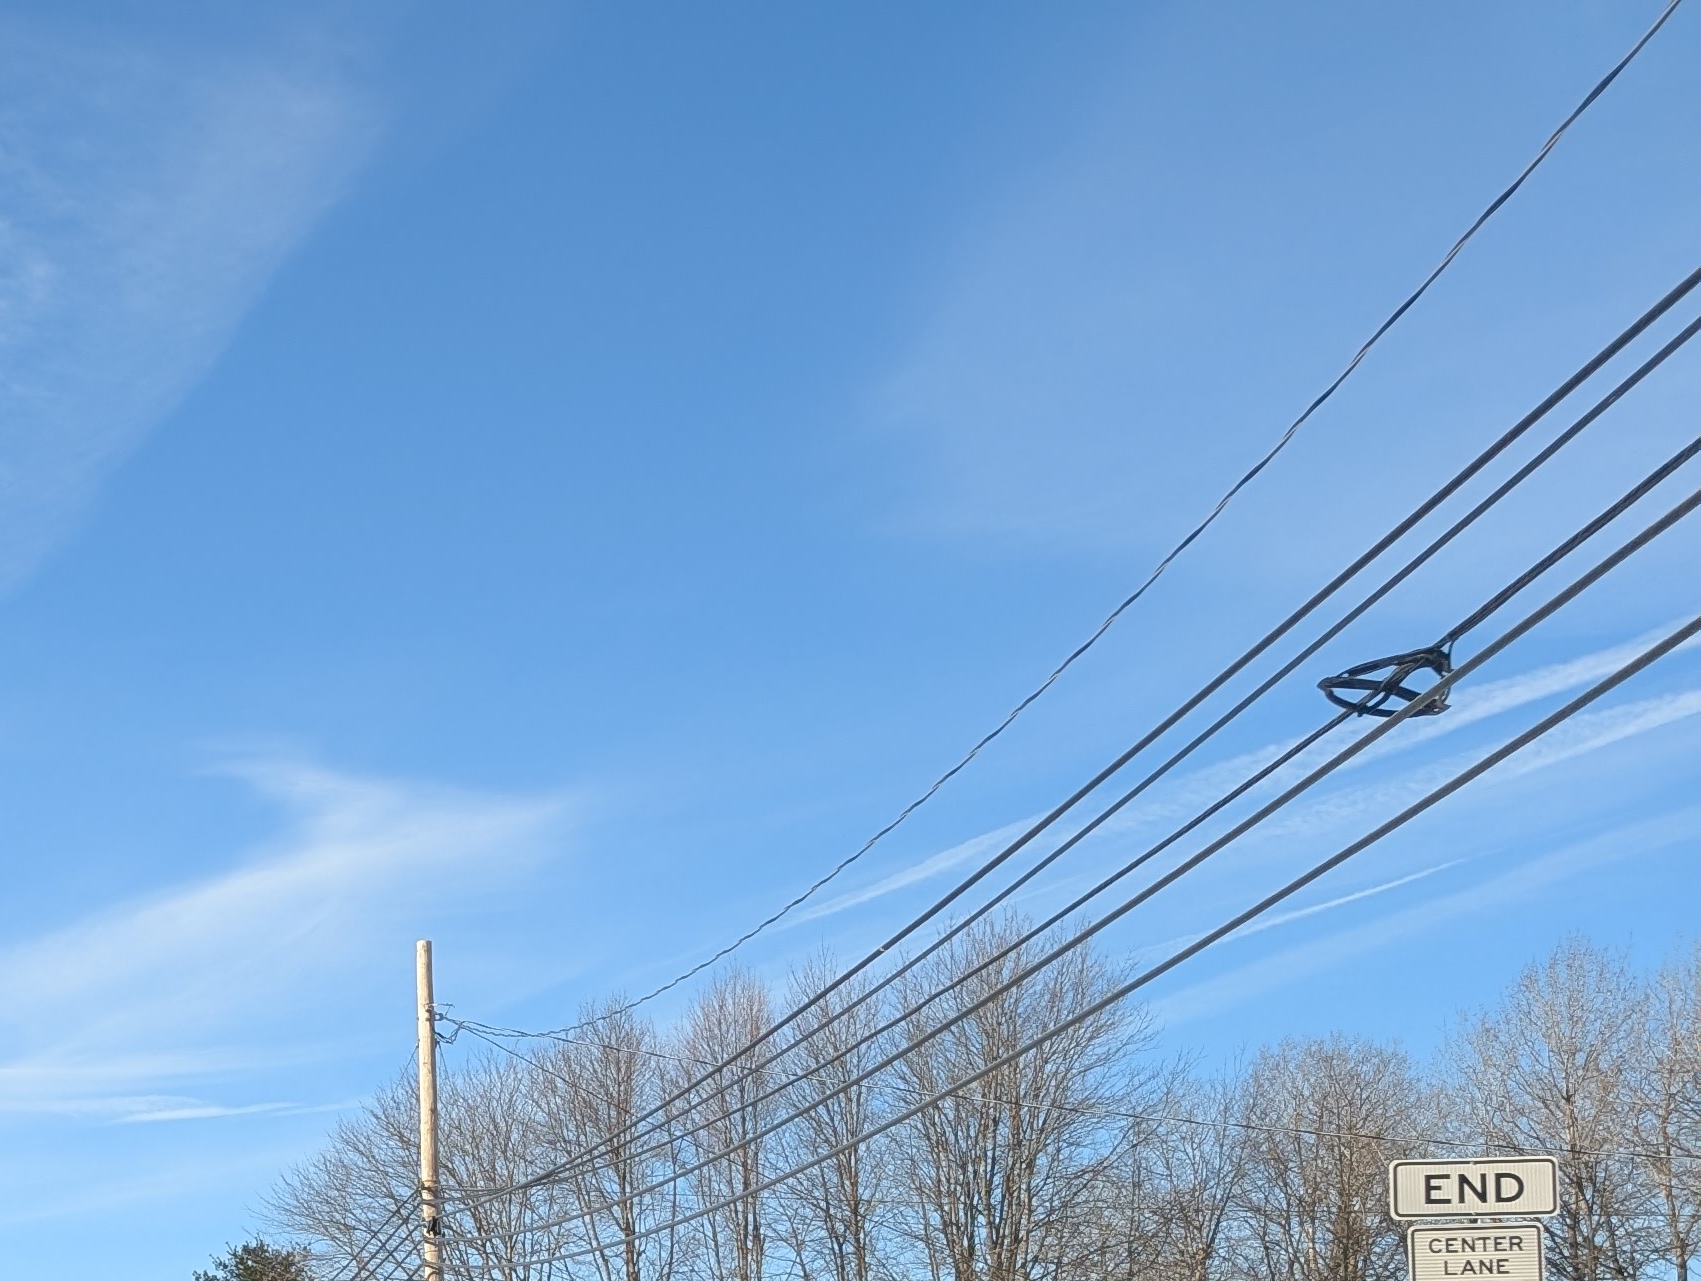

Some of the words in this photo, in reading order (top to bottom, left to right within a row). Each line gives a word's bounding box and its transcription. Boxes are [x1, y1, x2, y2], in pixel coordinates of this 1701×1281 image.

[1424, 1172, 1525, 1205] END
[1428, 1235, 1524, 1254] CENTER
[1443, 1258, 1511, 1276] LANE
